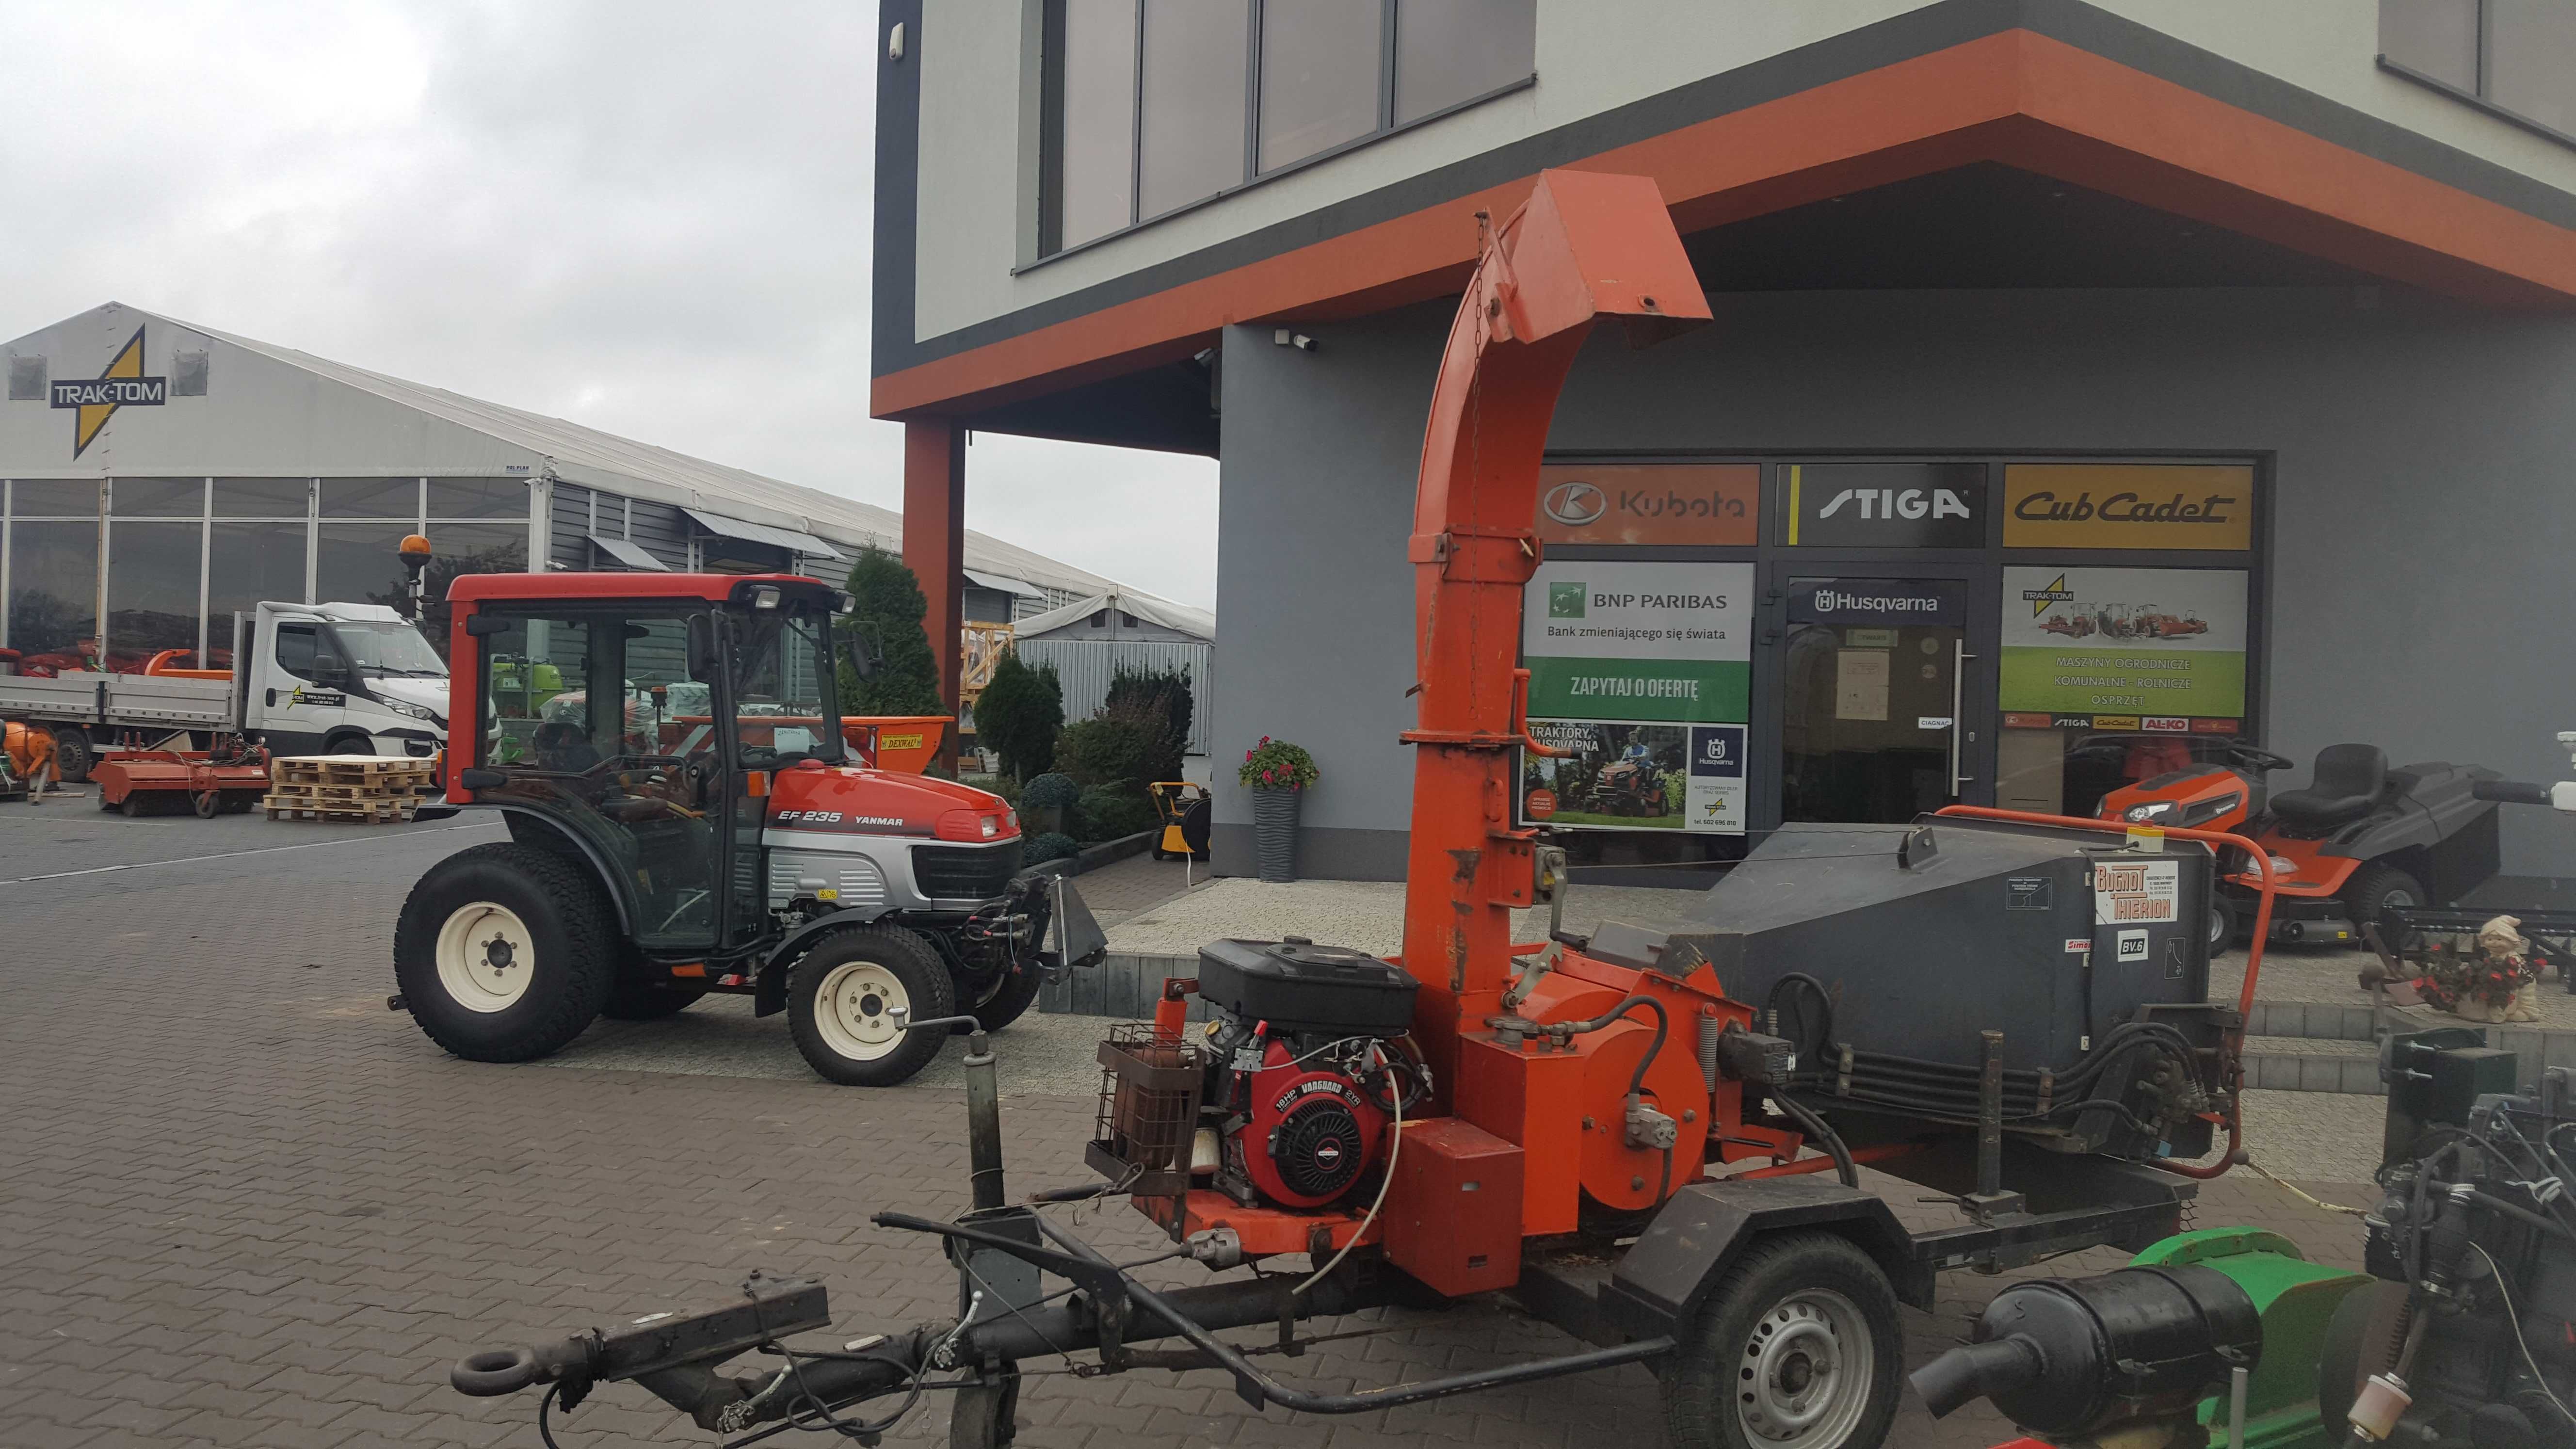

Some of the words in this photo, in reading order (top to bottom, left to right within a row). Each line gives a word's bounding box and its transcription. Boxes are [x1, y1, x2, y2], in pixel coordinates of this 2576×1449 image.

[54, 382, 162, 404] TRAK-TOM
[1620, 490, 1745, 517] Kubota
[1819, 488, 1970, 519] STIGA
[2014, 491, 2094, 521] Cub
[2097, 492, 2237, 523] Cadet
[1594, 594, 1635, 608] BNP
[1642, 595, 1727, 610] PARIBAS
[1837, 593, 1938, 613] Husqvarna
[2024, 591, 2073, 601] TRAK-TOM
[1547, 626, 1576, 637] Bank
[1579, 627, 1662, 641] zmieniającego
[1666, 628, 1682, 641] się
[1686, 627, 1726, 640] świata
[2056, 657, 2111, 669] MASZYNY
[2114, 658, 2191, 670] OGRODNICZE
[1571, 676, 1632, 697] ZAPYTAJ
[1635, 678, 1644, 696] O
[1648, 678, 1699, 701] OFERTĘ
[2054, 676, 2127, 687] KOMUNALNE
[2137, 677, 2191, 689] ROLNICZE
[2091, 695, 2145, 708] OSPRZĘT
[2055, 719, 2089, 727] STIGA
[2145, 719, 2186, 730] AL-KO
[778, 810, 801, 820] EF
[802, 810, 843, 823] 235
[855, 816, 903, 826] YANMAR
[2095, 865, 2149, 892] BUGNOT
[2110, 892, 2171, 920] THIERION
[1301, 1080, 1342, 1094] VANGUARD
